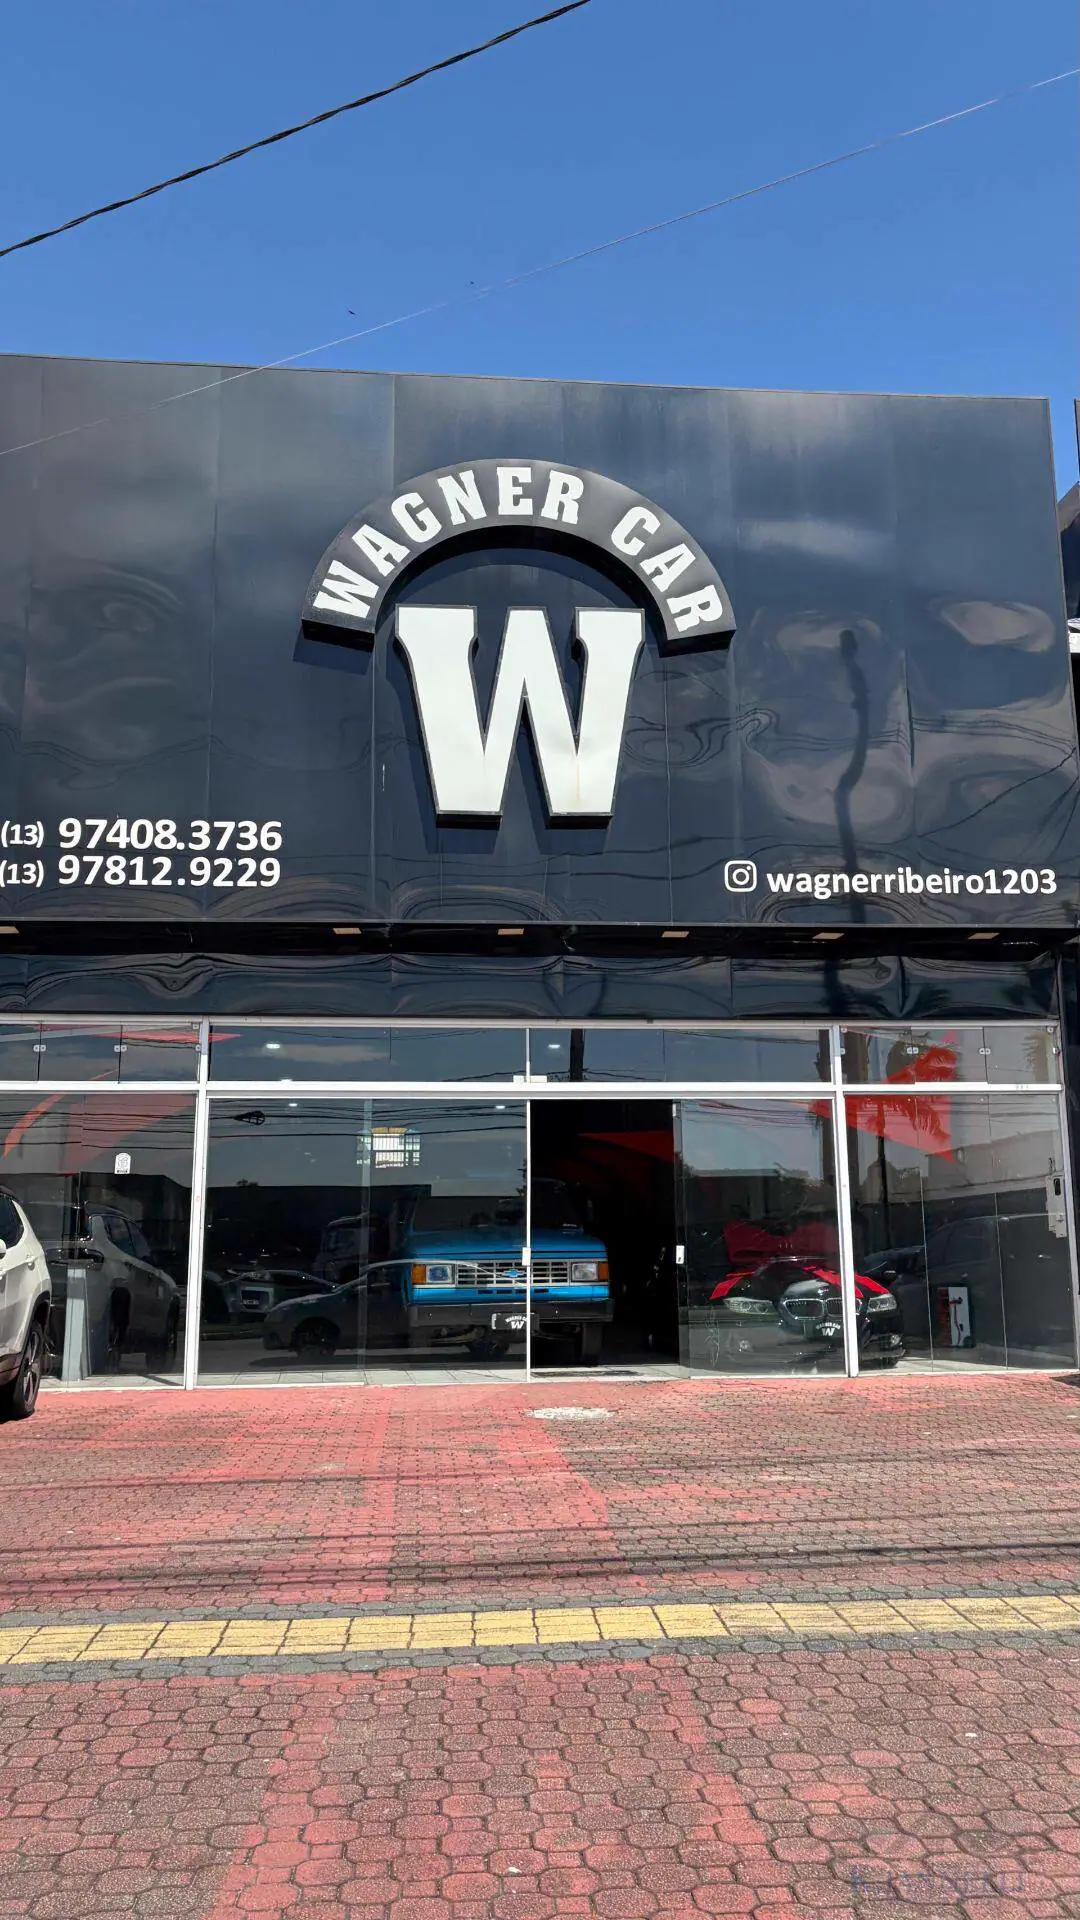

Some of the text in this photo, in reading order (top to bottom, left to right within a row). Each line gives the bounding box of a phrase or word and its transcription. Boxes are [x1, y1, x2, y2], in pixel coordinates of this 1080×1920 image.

[313, 467, 723, 632] WAGNER CAR
[398, 607, 644, 814] W
[1, 818, 282, 850] (13) 97408.3736
[0, 855, 281, 887] (13) 97812.9229
[767, 867, 1057, 899] wagnerribeiro1203
